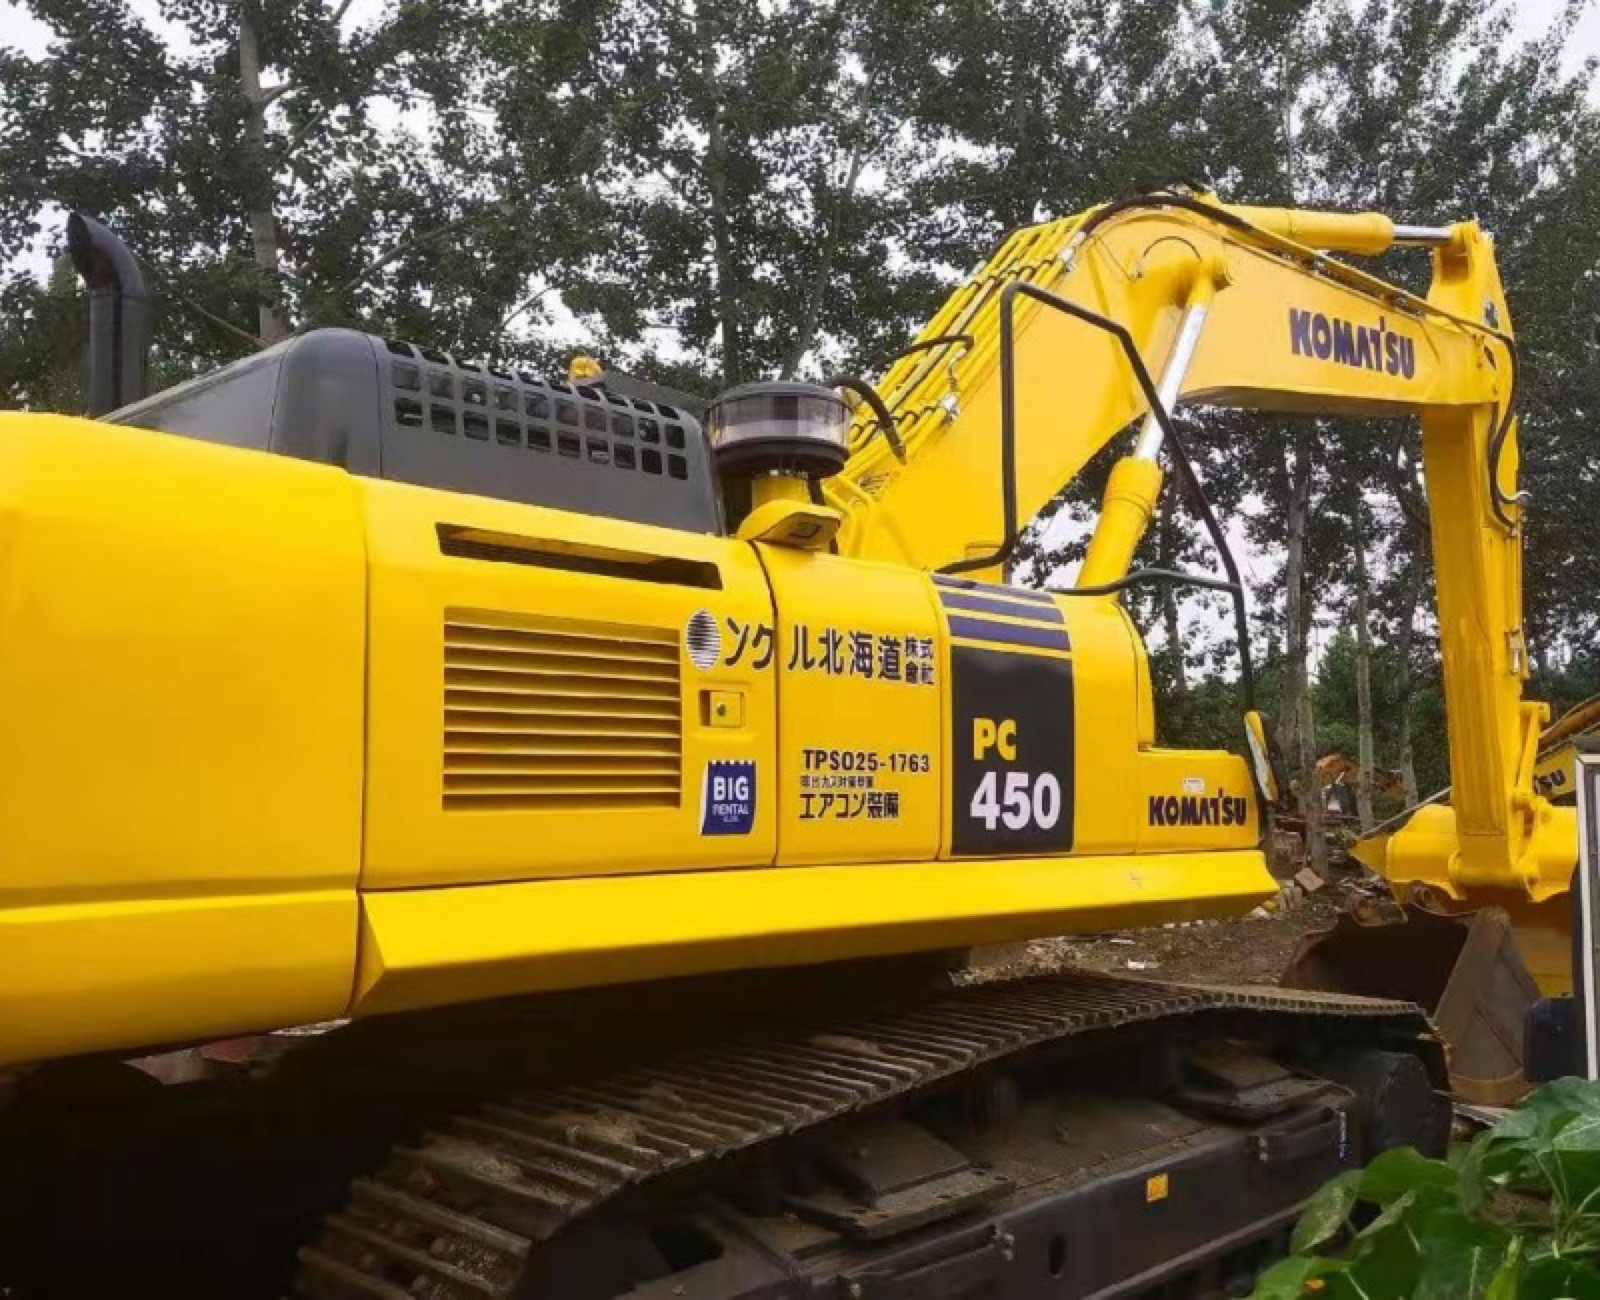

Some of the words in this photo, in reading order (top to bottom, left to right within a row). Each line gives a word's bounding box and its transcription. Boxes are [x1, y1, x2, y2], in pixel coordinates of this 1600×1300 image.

[1289, 307, 1415, 380] KOMATSU
[973, 718, 1017, 760] PC
[713, 776, 749, 801] BIG
[970, 772, 1060, 830] 450
[1150, 788, 1247, 826] KOMATSU
